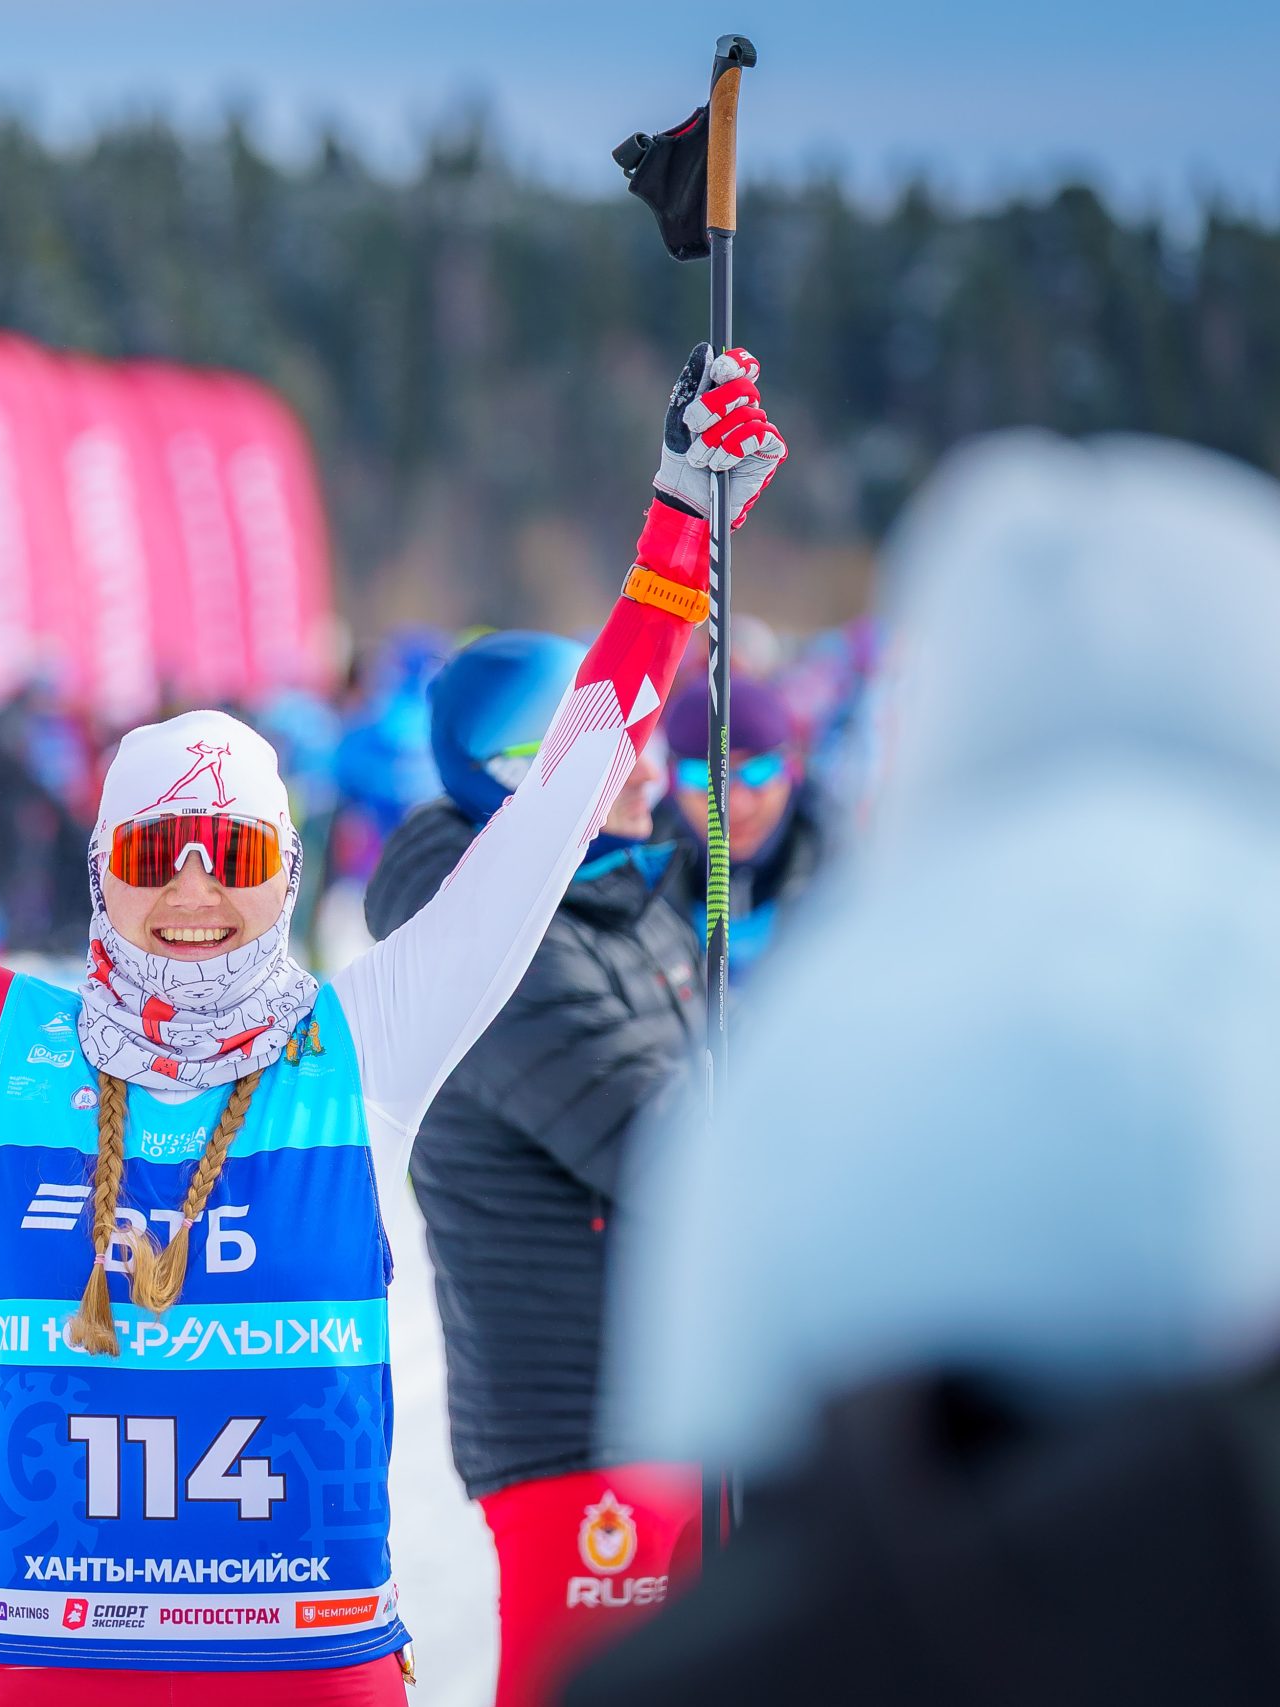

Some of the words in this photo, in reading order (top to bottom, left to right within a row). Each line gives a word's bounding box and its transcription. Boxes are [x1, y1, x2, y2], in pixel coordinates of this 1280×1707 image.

[720, 724, 728, 755] TEAM
[104, 1204, 257, 1273] ВТБ
[67, 1413, 287, 1521] 114
[24, 1553, 331, 1584] ХАНТЫ-МАНСИЙСК
[93, 1605, 149, 1618] СПОРТ
[160, 1608, 280, 1625] РОСГОССТРАХ
[317, 1604, 373, 1617] ЧЕМПИОНАТ
[92, 1619, 146, 1629] ЭКСПРЕСС
